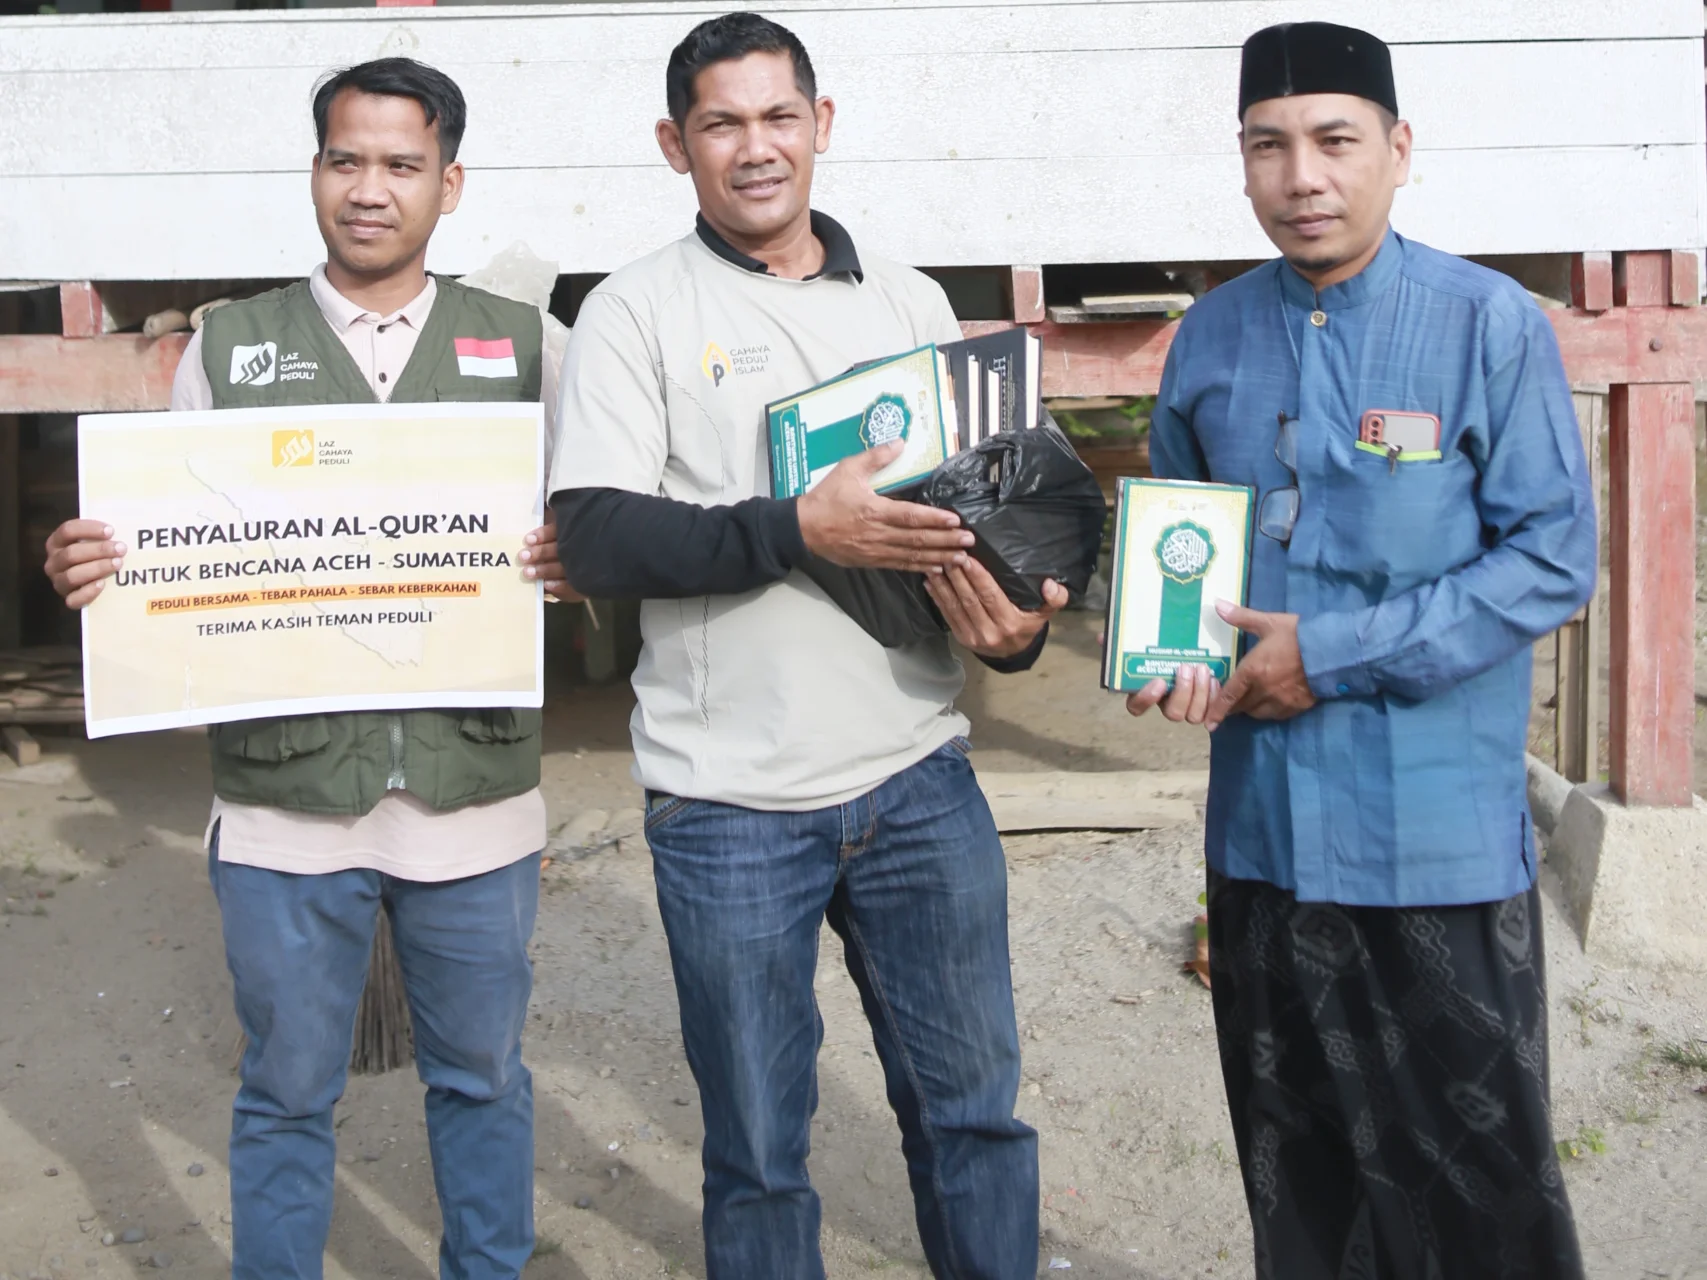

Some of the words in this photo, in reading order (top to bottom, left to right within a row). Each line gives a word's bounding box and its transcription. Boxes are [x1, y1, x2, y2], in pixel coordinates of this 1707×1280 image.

[729, 344, 771, 357] CAHAYA
[280, 352, 299, 362] LAZ
[732, 355, 769, 366] PEDULI
[280, 361, 318, 372] CAHAYA
[735, 365, 765, 376] ISLAM
[280, 372, 315, 382] PEDULI
[319, 449, 353, 457] CAHAYA
[137, 517, 323, 549] PENYALURAN
[331, 514, 489, 539] AL-QUR'AN
[115, 565, 191, 587] UNTUK
[199, 557, 306, 580] BENCANA
[312, 554, 371, 572] ACEH
[393, 552, 511, 568] SUMATERA
[151, 598, 190, 610] PEDULI
[193, 593, 250, 606] BERSAMA
[260, 591, 297, 601] TEBAR
[300, 587, 347, 598] PAHALA
[358, 586, 395, 595] SEBAR
[399, 583, 477, 594] KEBERKAHAN
[196, 620, 257, 637] TERIMA
[262, 616, 312, 631] KASIH
[316, 613, 373, 627] TEMAN
[378, 611, 433, 624] PEDULI
